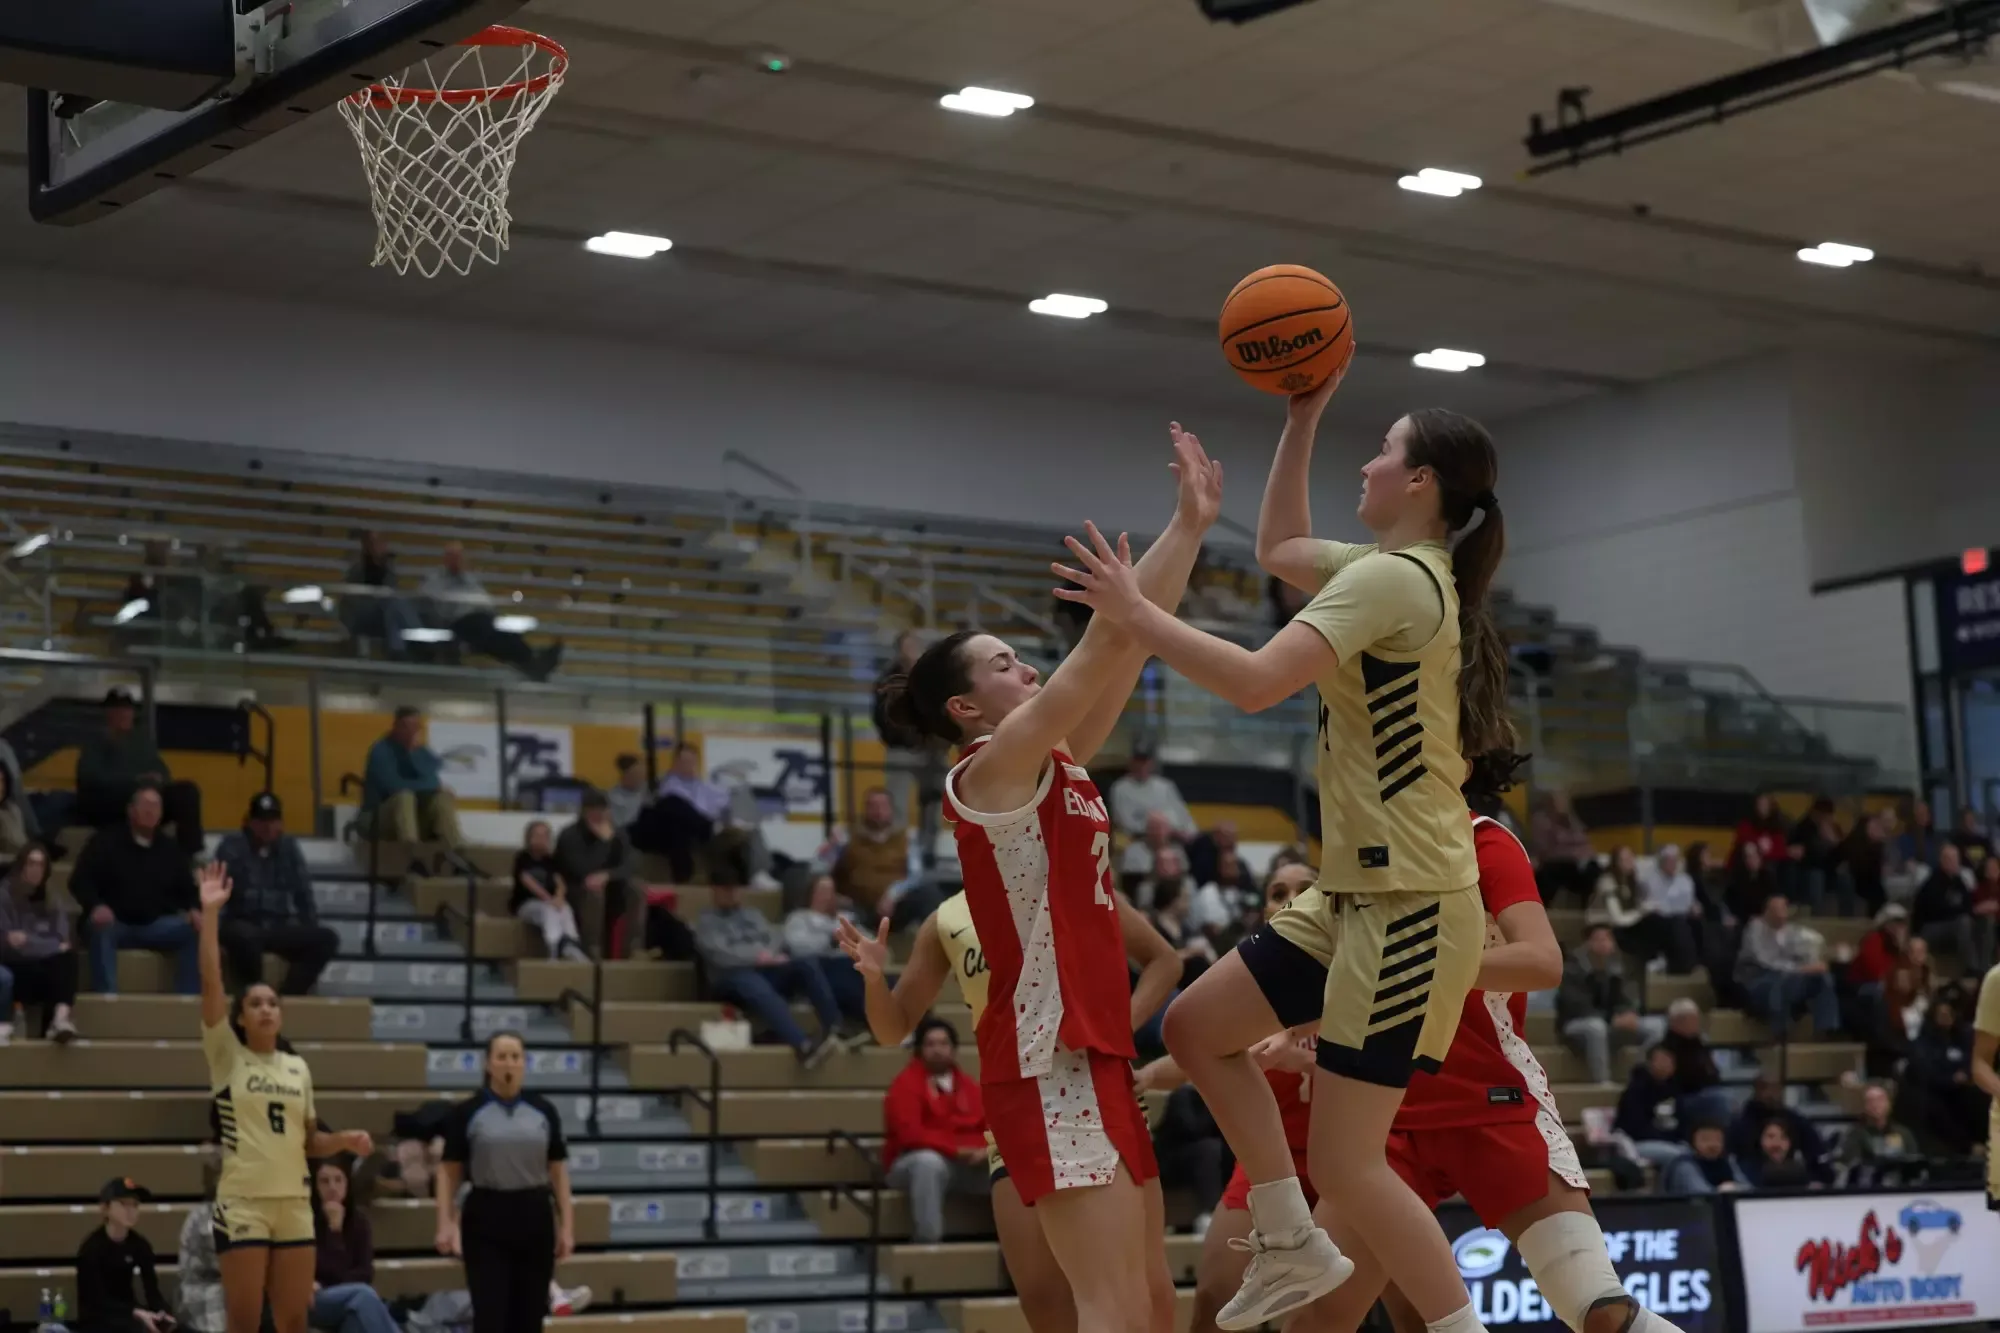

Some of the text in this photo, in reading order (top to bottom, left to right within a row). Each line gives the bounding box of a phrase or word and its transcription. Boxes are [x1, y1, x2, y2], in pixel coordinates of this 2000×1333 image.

[1236, 327, 1324, 364] Wilson
[267, 1101, 286, 1136] 6
[1633, 1229, 1680, 1262] THE
